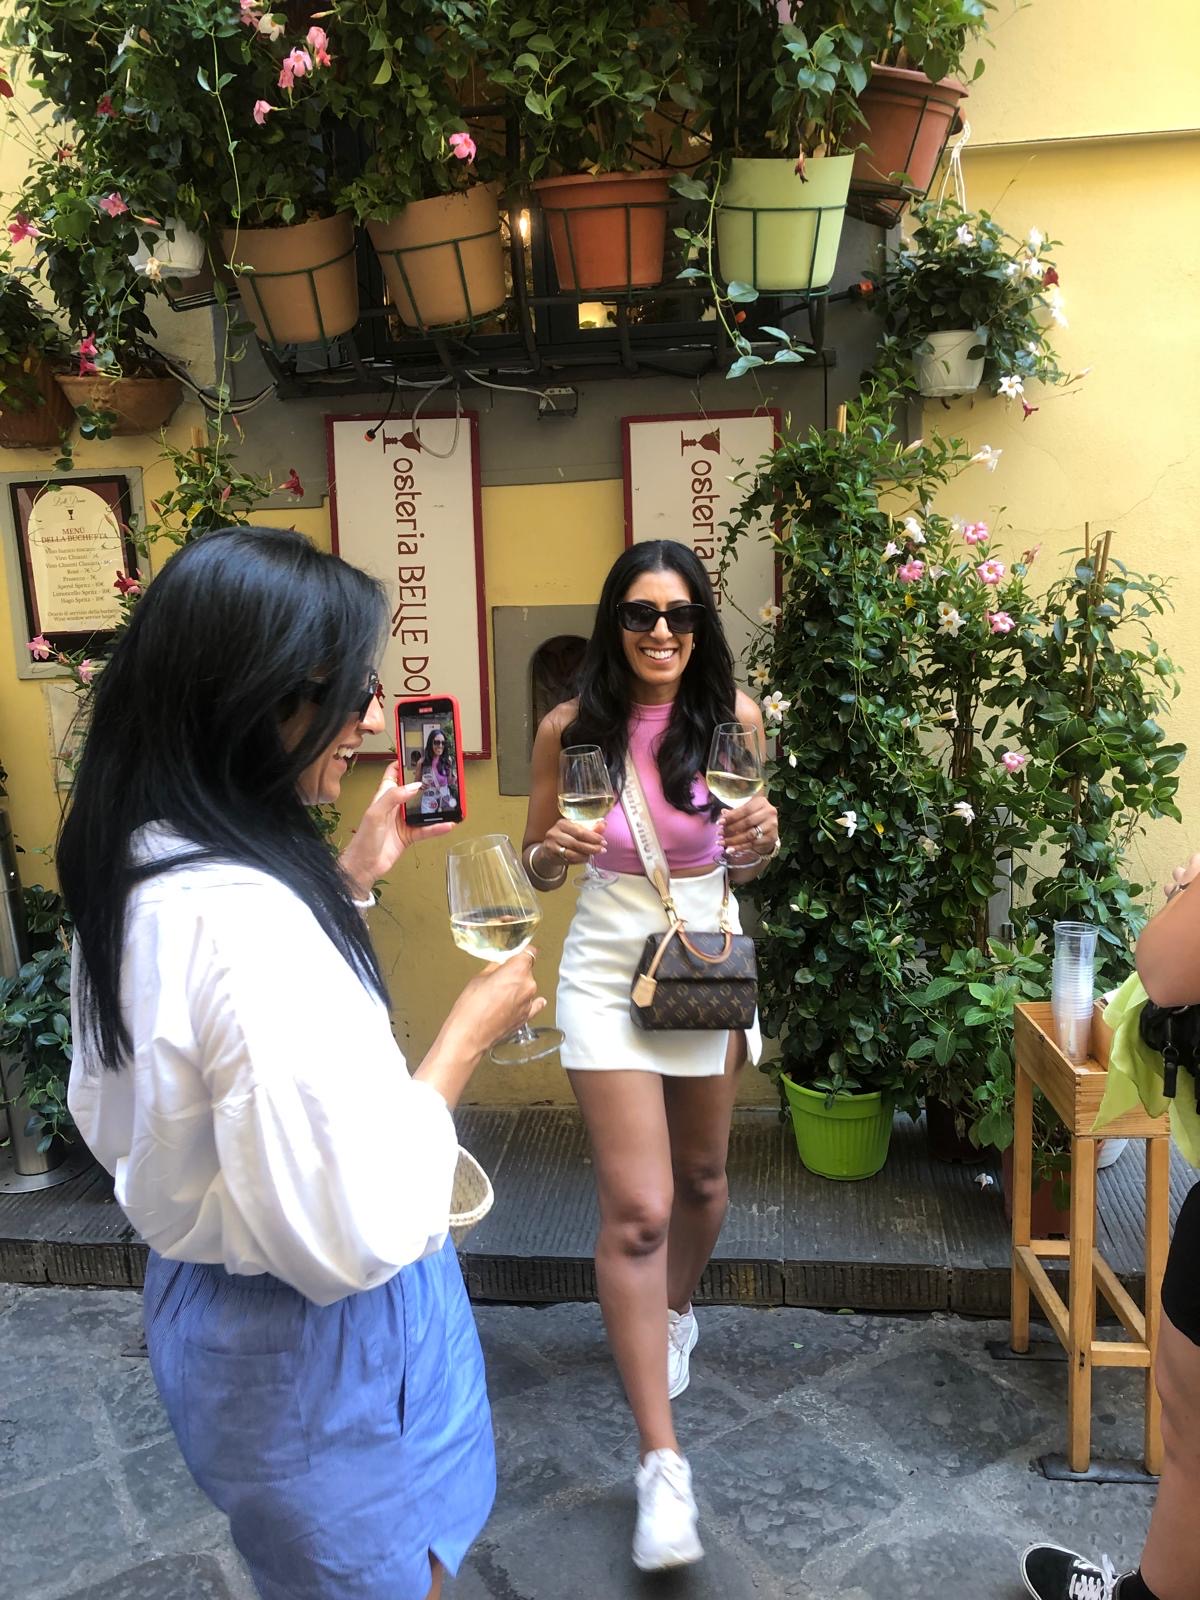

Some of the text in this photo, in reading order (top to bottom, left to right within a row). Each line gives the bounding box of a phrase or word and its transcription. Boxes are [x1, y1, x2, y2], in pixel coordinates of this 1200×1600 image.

[41, 535, 66, 543] DELLA
[691, 459, 722, 561] osteria
[392, 457, 431, 697] osteria BELLE DO
